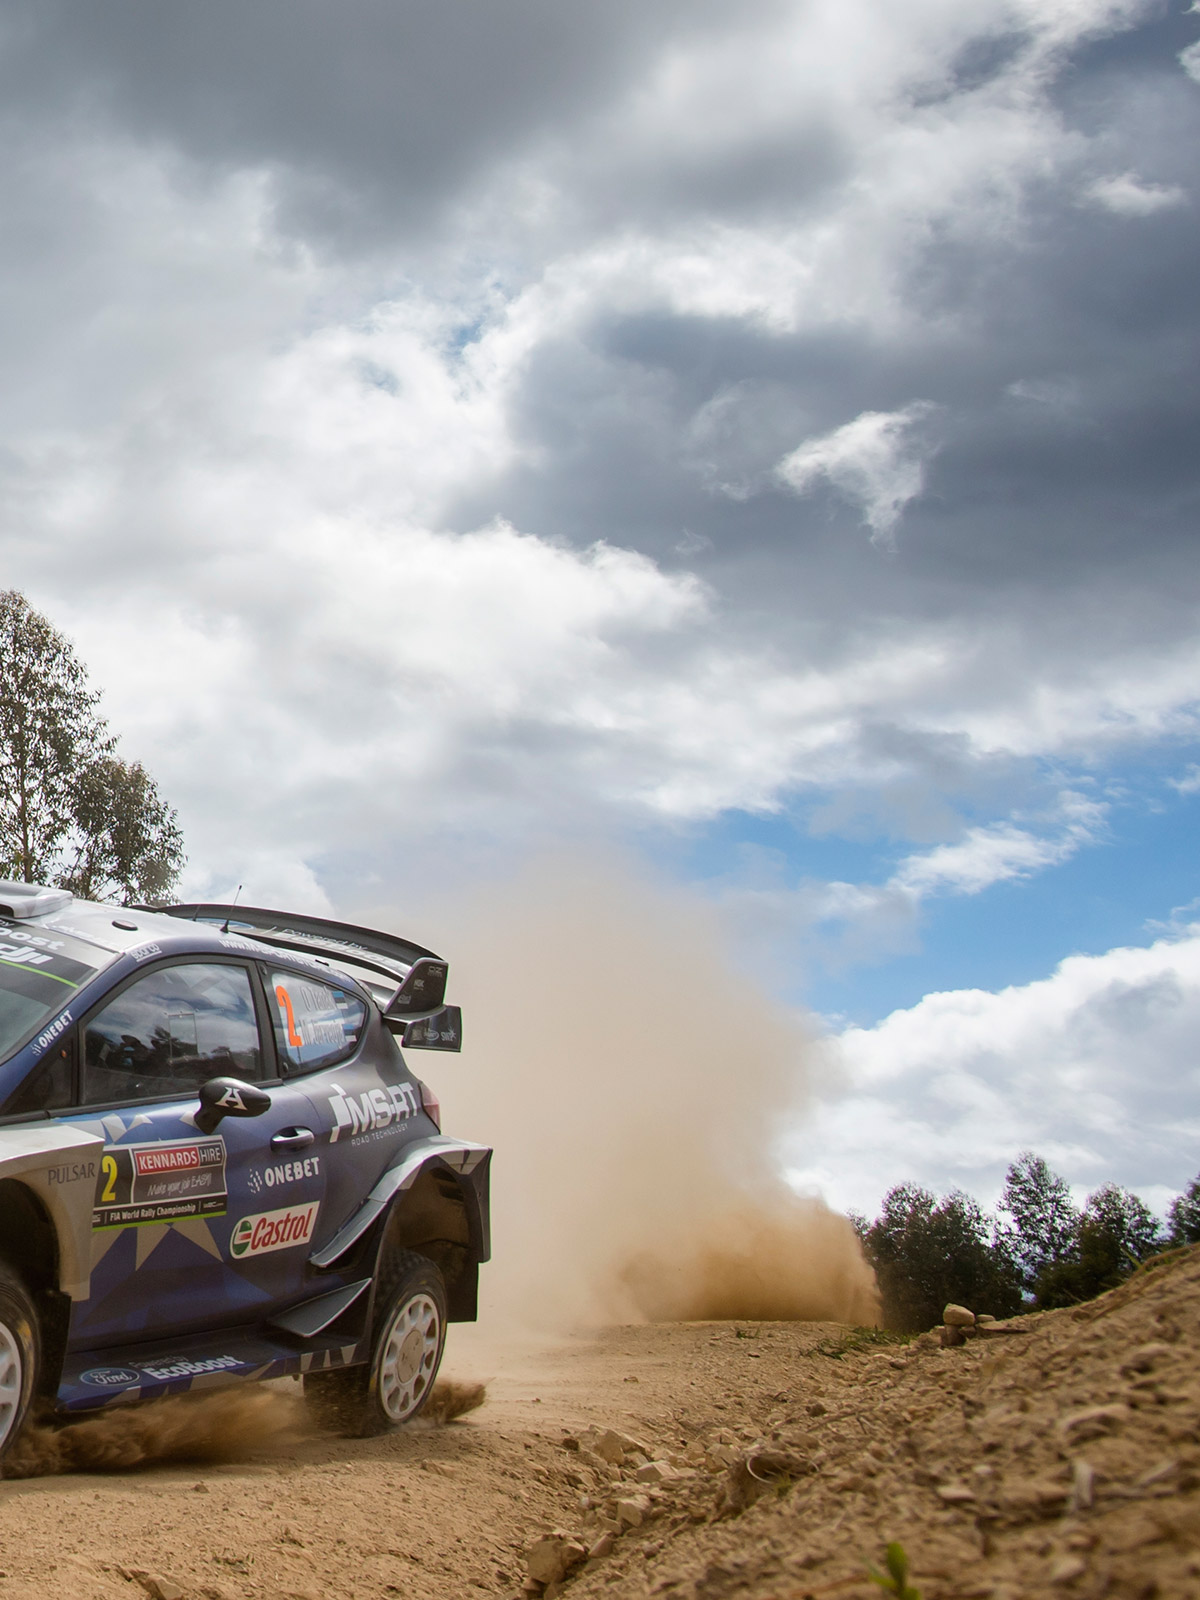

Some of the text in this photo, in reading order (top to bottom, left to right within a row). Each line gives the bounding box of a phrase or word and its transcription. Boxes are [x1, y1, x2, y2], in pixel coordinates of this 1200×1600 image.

[38, 1009, 74, 1049] ONEBET
[275, 984, 303, 1047] 2
[344, 1082, 418, 1136] MS-RT
[351, 1122, 409, 1147] ROAD TECHNOLOGY
[138, 1146, 221, 1171] KENNARDS HIRE
[264, 1156, 320, 1187] ONEBET
[47, 1161, 97, 1187] PULSAR
[101, 1155, 118, 1202] 2
[110, 1211, 121, 1221] FIA
[121, 1209, 140, 1220] World
[140, 1207, 156, 1219] Rally
[156, 1203, 196, 1217] Championship
[250, 1207, 313, 1251] Castrol
[88, 1369, 134, 1385] Ford
[141, 1354, 246, 1380] EcoBoost
